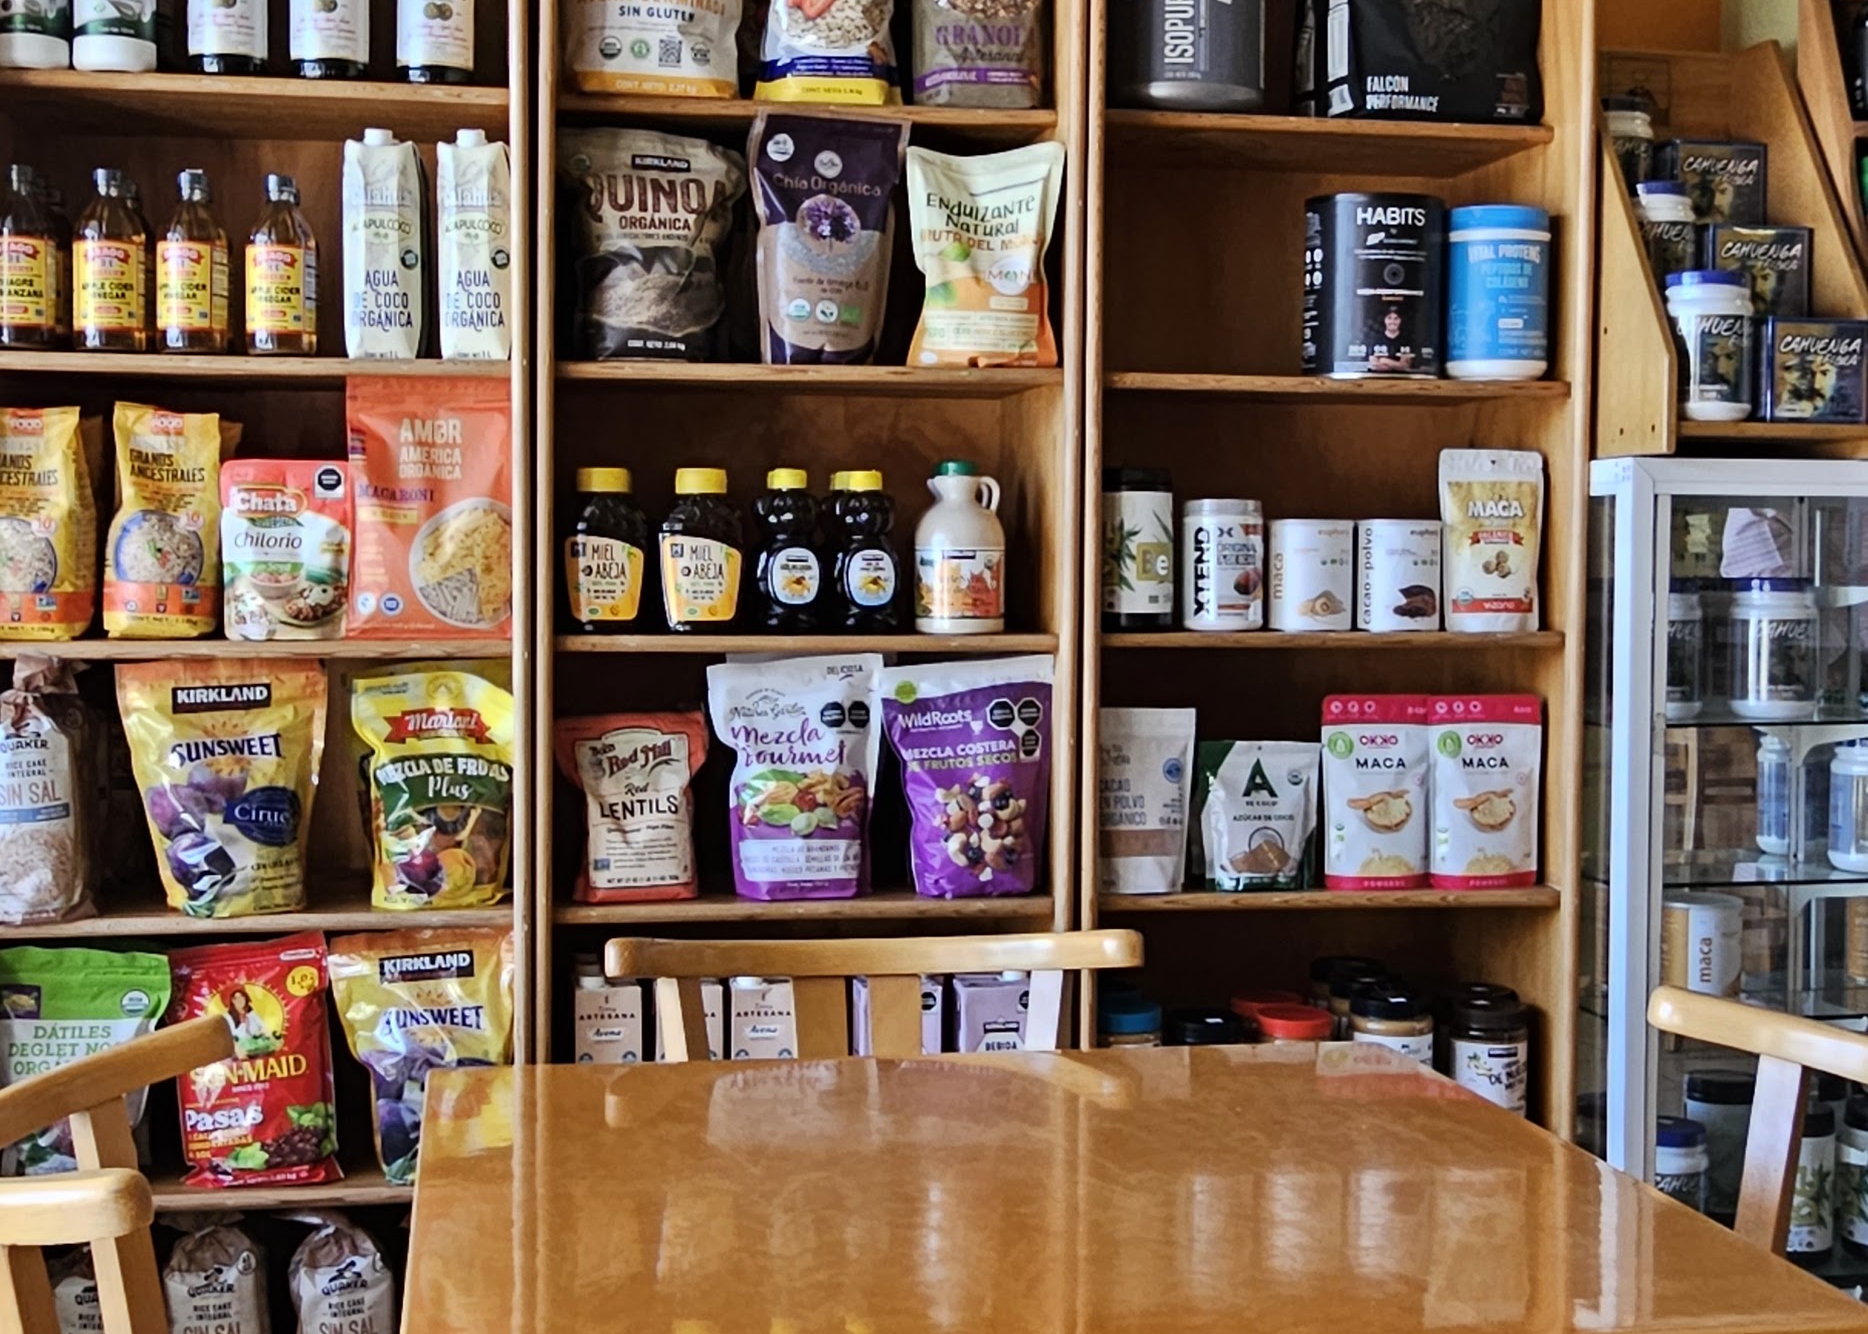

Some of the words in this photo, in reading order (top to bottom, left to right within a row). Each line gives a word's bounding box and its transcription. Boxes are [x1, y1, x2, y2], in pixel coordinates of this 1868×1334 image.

[618, 5, 641, 17] SIN
[646, 6, 695, 23] GLUTEN
[1366, 75, 1409, 93] FALCON
[1365, 94, 1439, 113] PERFORMANCE
[634, 157, 689, 169] KIRKLAND
[1682, 156, 1759, 175] CAHUENGA
[772, 173, 808, 191] Chía
[810, 175, 882, 197] Orgánica
[586, 173, 729, 223] QUINOA
[619, 214, 692, 232] ORGÁNICA
[1356, 206, 1426, 226] HABITS
[967, 236, 995, 252] DEL
[1721, 241, 1803, 259] CAHUENGA
[109, 280, 134, 292] CIDER
[181, 282, 207, 293] CIDER
[274, 286, 301, 296] CIDER
[365, 270, 399, 294] AGUA
[456, 270, 490, 293] AGUA
[353, 292, 368, 309] DE
[375, 292, 409, 309] COCO
[467, 292, 501, 309] COCO
[351, 310, 413, 332] ORGÁNICA
[445, 310, 505, 332] ORGÁNICA
[1780, 335, 1864, 354] CAHUENGA
[129, 464, 206, 483] ANCESTRALES
[236, 491, 297, 513] Chata
[358, 484, 435, 502] MACARONI
[1467, 500, 1525, 518] MACA
[234, 528, 303, 550] Chilorio
[591, 544, 616, 562] MIEL
[689, 544, 713, 562] MIEL
[594, 563, 628, 579] ABEJA
[693, 563, 725, 580] ABEJA
[1193, 526, 1211, 617] XTEND
[1273, 553, 1284, 600] maca
[176, 687, 268, 704] KIRKLAND
[404, 711, 480, 732] Mariani
[898, 710, 972, 729] WildRoots
[731, 717, 824, 746] Mezcla
[0, 738, 49, 753] QUAKER
[169, 732, 284, 767] SUNSWEET
[903, 746, 955, 761] MEZCLA
[956, 740, 1017, 757] COSTERA
[606, 746, 638, 779] Red
[640, 738, 673, 769] Mill
[923, 756, 974, 771] FRUTOS
[976, 752, 1018, 766] SECOS
[1356, 757, 1407, 769] MACA
[1462, 756, 1509, 769] MACA
[375, 760, 432, 786] MEZCLA
[433, 757, 455, 775] DE
[456, 756, 511, 782] FRUTAS
[1242, 757, 1279, 799] A
[0, 782, 23, 806] SIN
[29, 780, 62, 804] SAL
[427, 775, 475, 799] Plus
[624, 781, 649, 797] Red
[599, 794, 679, 820] LENTILS
[1114, 795, 1145, 809] POLVO
[382, 952, 472, 977] KIRKLAND
[1700, 937, 1713, 984] maca
[384, 1005, 484, 1033] SUNSWEET
[34, 1024, 111, 1040] DÁTILES
[8, 1042, 80, 1058] DEGLET
[187, 1282, 235, 1299] QUAKER
[321, 1278, 368, 1296] QUAKER
[74, 1293, 100, 1306] QUA
